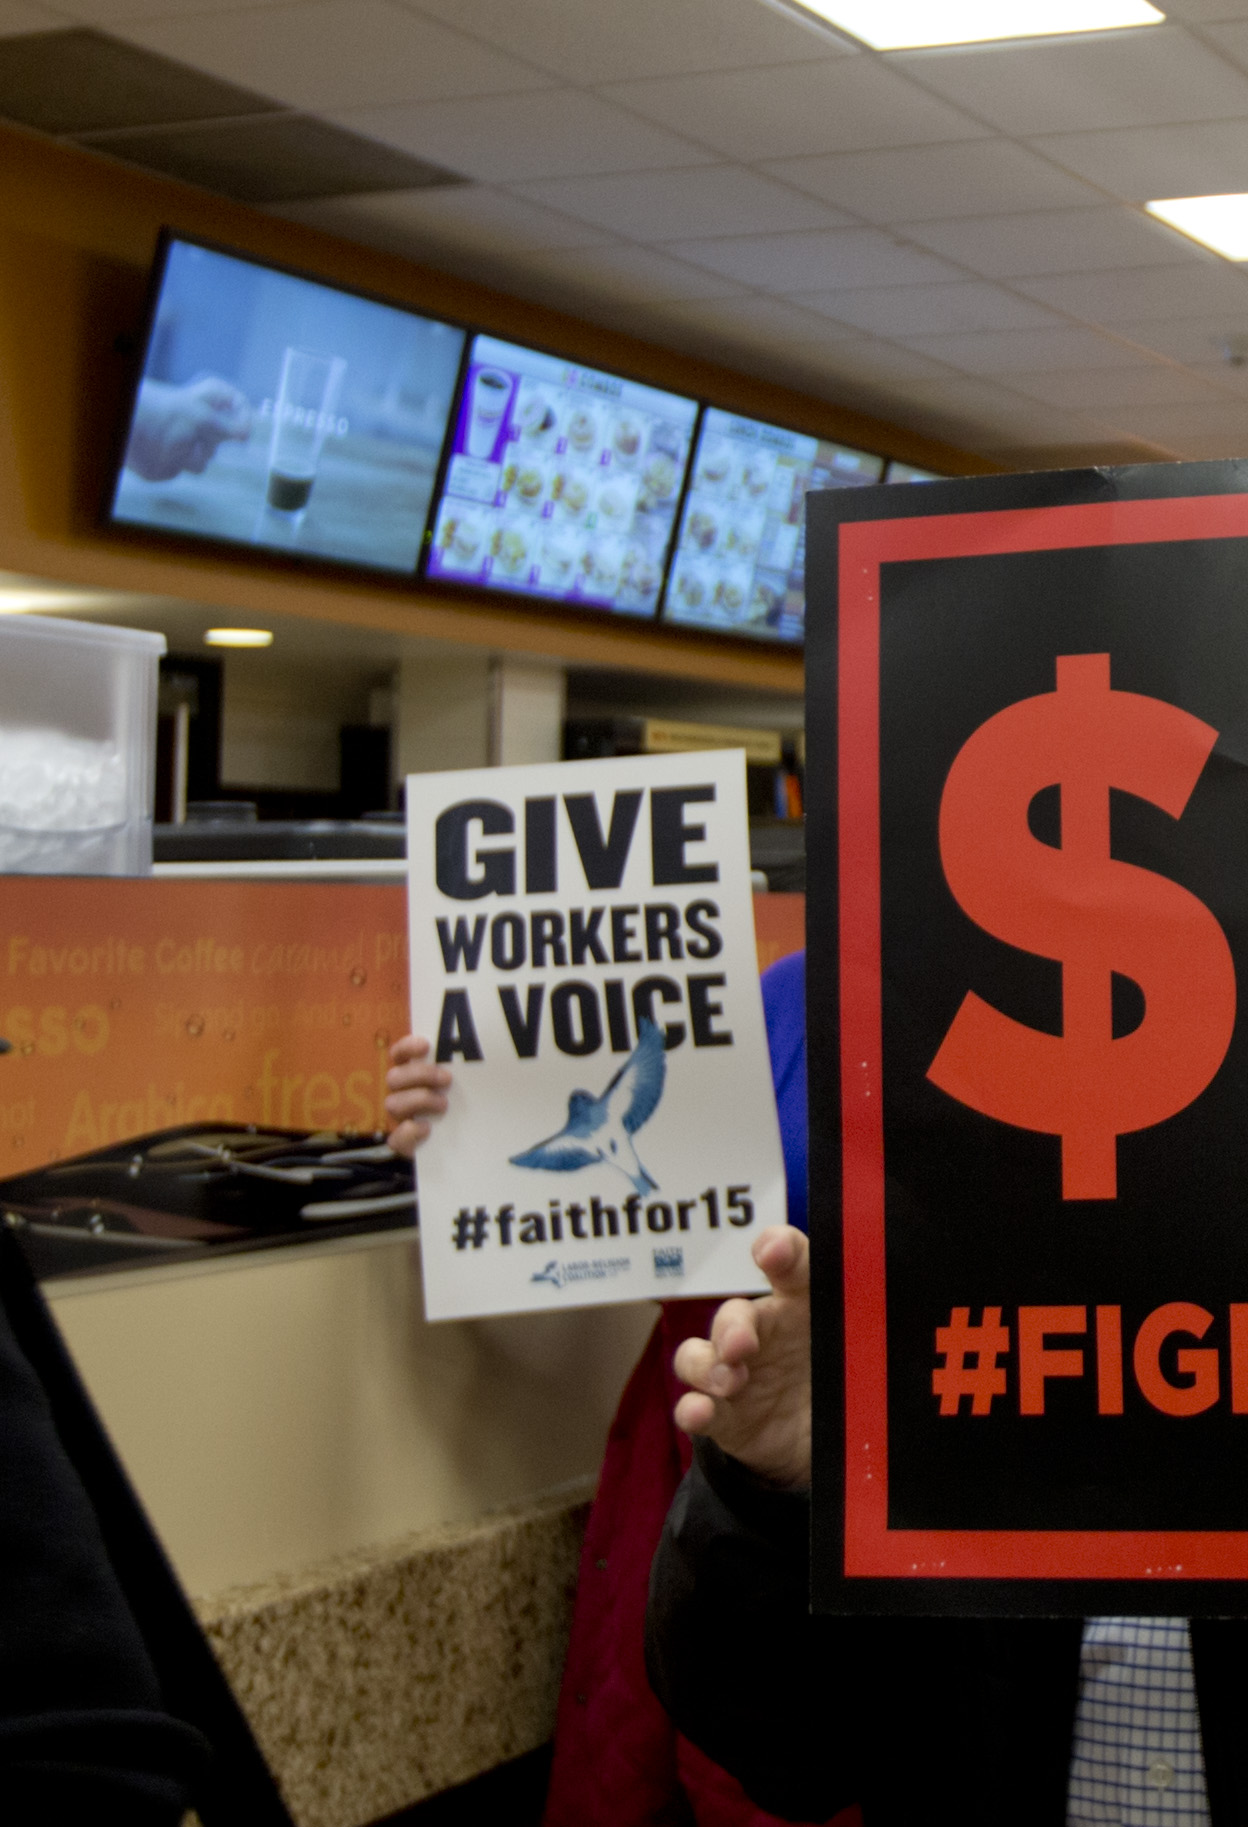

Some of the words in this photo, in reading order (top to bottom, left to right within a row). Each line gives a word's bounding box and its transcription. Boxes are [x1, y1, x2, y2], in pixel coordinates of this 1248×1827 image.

[435, 783, 721, 900] GIVE
[7, 935, 145, 976] Favorite
[155, 937, 244, 975] Coffee
[435, 899, 723, 973] WORKERS
[435, 988, 484, 1063] A
[499, 974, 734, 1059] VOICE
[452, 1184, 755, 1250] #faithfor15
